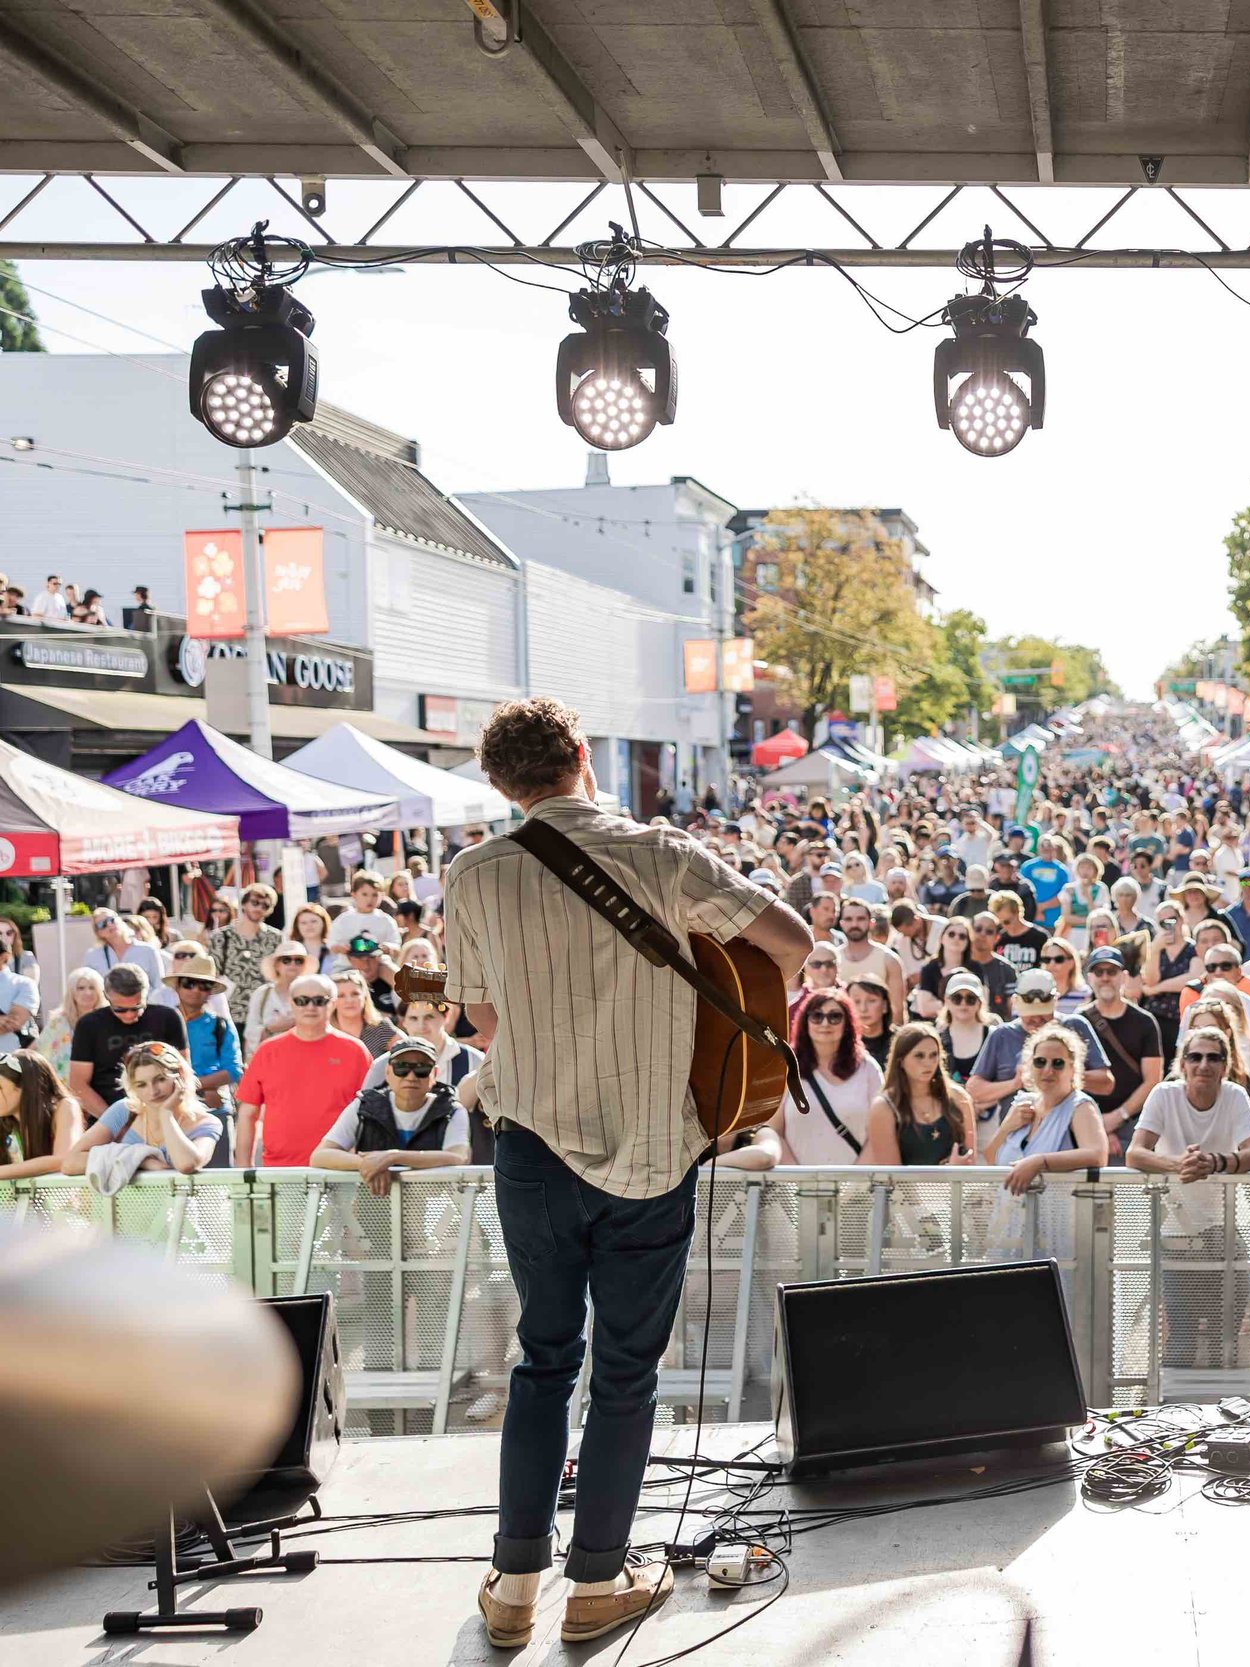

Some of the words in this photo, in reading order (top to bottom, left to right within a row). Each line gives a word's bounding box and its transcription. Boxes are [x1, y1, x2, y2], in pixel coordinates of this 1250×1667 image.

[25, 643, 84, 664] Japanese
[86, 648, 146, 671] Restaurant
[294, 653, 355, 693] GOOSE
